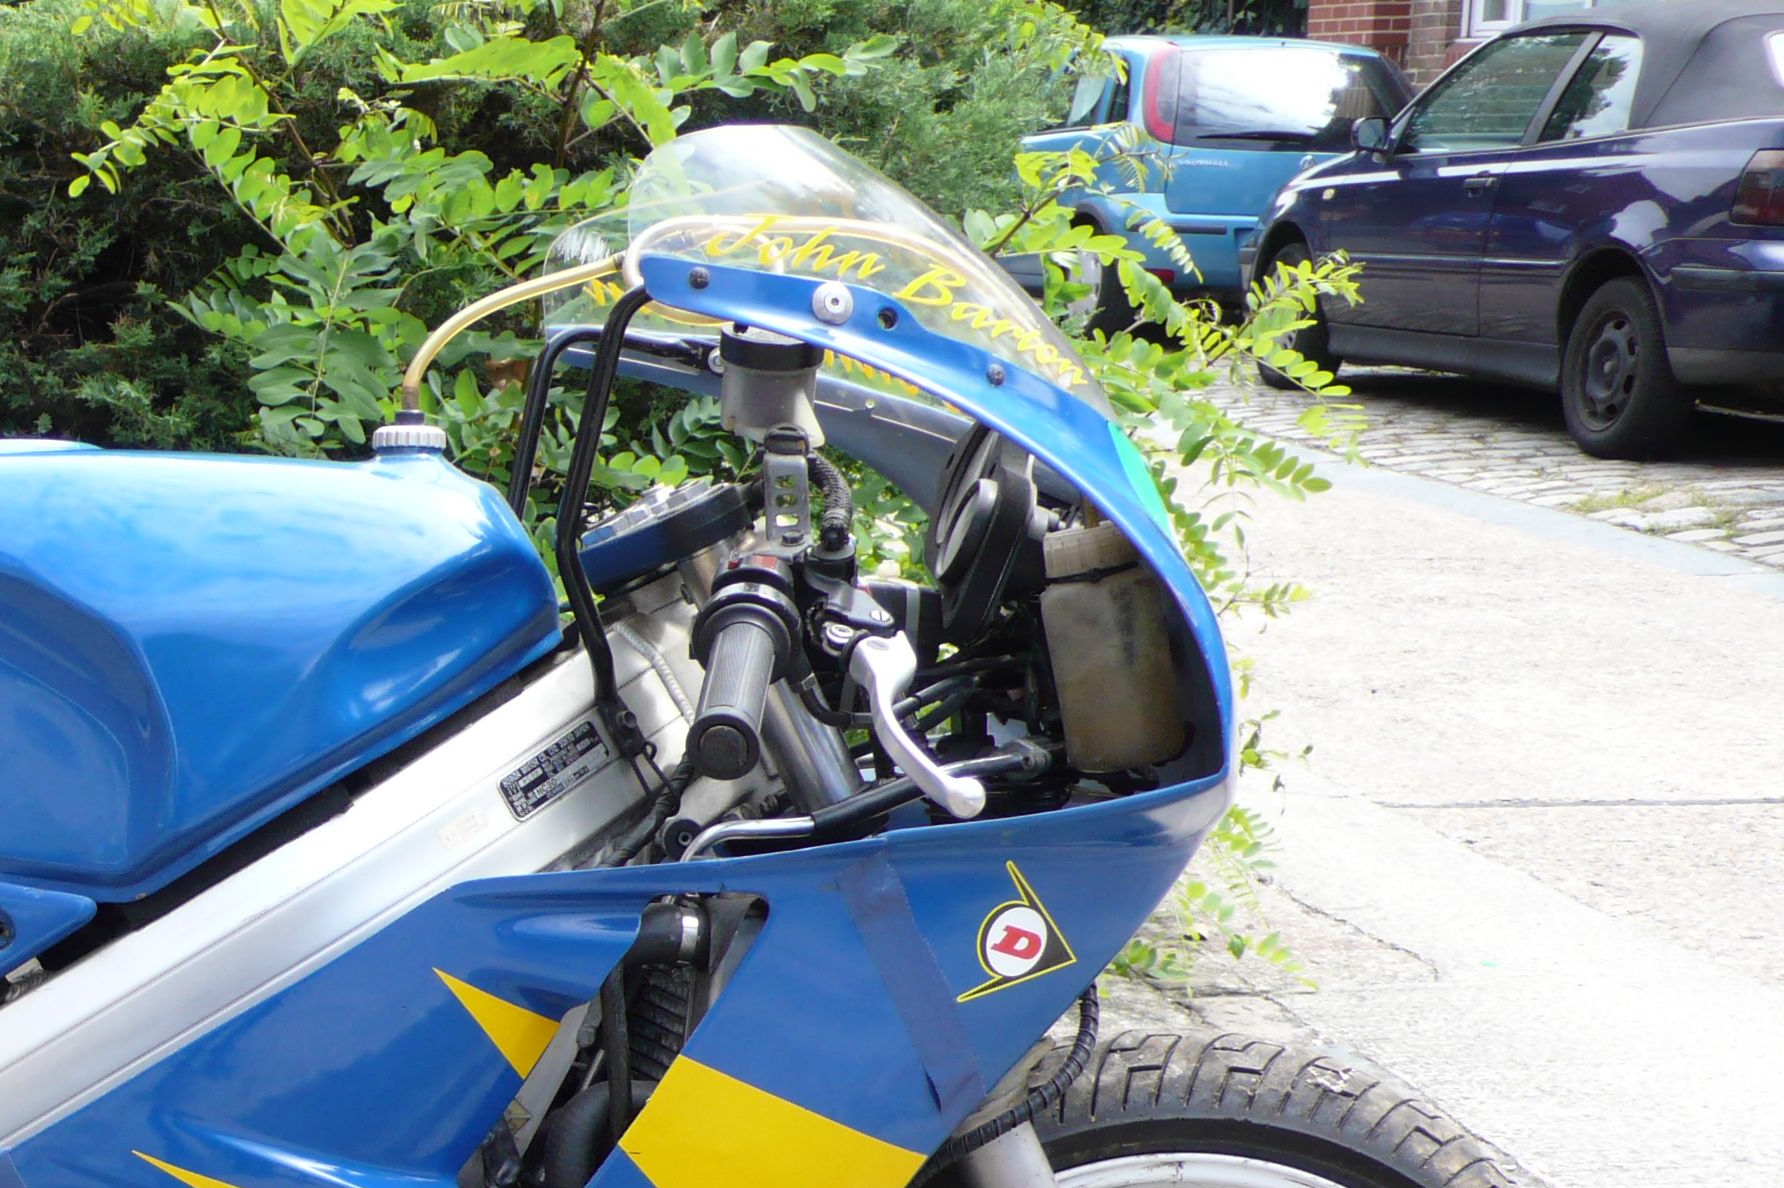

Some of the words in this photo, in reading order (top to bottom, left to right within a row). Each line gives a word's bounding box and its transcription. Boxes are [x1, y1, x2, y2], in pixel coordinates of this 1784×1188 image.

[705, 213, 885, 279] John
[893, 263, 1087, 384] Barton
[990, 924, 1042, 960] D
